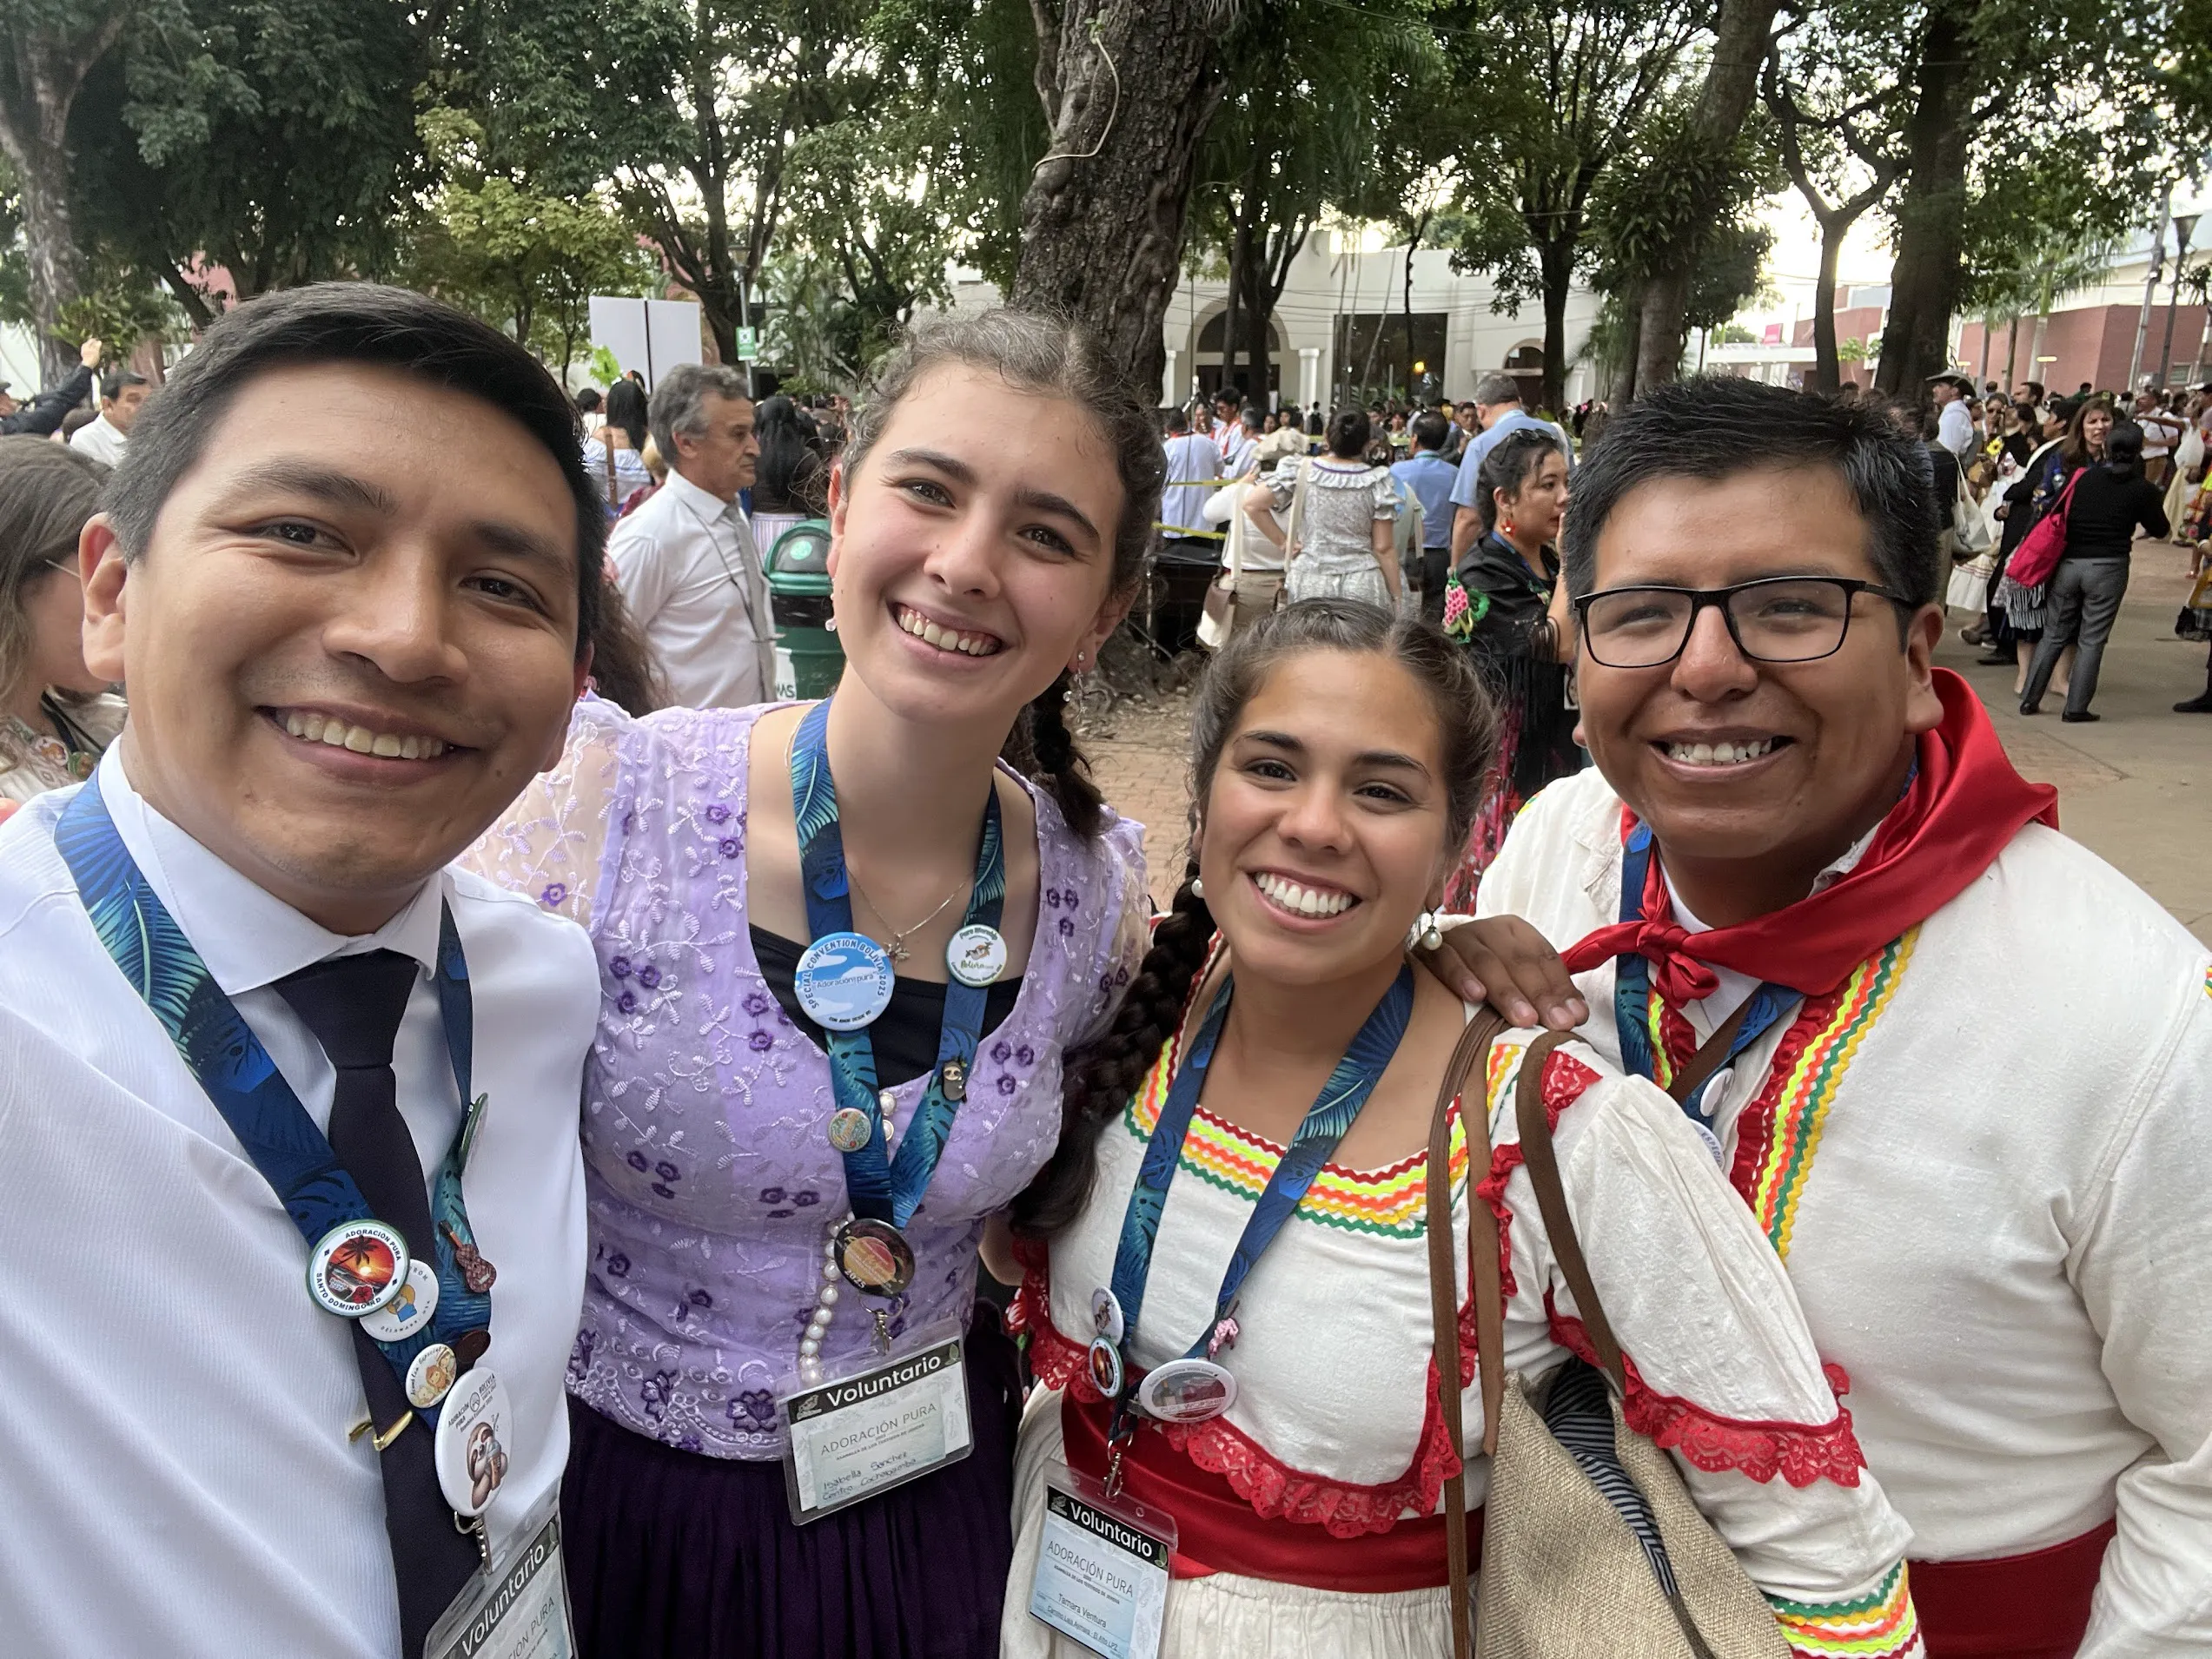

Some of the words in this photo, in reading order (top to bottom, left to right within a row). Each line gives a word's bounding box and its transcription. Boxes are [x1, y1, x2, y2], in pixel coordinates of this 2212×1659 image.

[807, 940, 857, 968] CONVENTION
[858, 943, 885, 971] BOLIVIA
[804, 973, 819, 1009] SPECIAL
[878, 975, 886, 996] 2025
[345, 1229, 391, 1242] ADORACIÓN
[389, 1241, 401, 1261] PURA
[316, 1272, 328, 1299] SANTO
[328, 1298, 366, 1311] DOMINGO
[844, 1270, 866, 1288] 2025
[826, 1354, 941, 1407] Voluntario
[821, 1418, 898, 1456] ADORACIÓN
[903, 1403, 937, 1424] PURA
[824, 1470, 862, 1490] Isabella
[1070, 1502, 1153, 1557] Voluntario
[1047, 1541, 1103, 1580] ADORACIÓN
[1106, 1573, 1133, 1597] PURA
[461, 1544, 544, 1656] Voluntario
[531, 1596, 554, 1635] PURA
[1058, 1593, 1081, 1613] Tamara
[1083, 1607, 1107, 1628] Ventura
